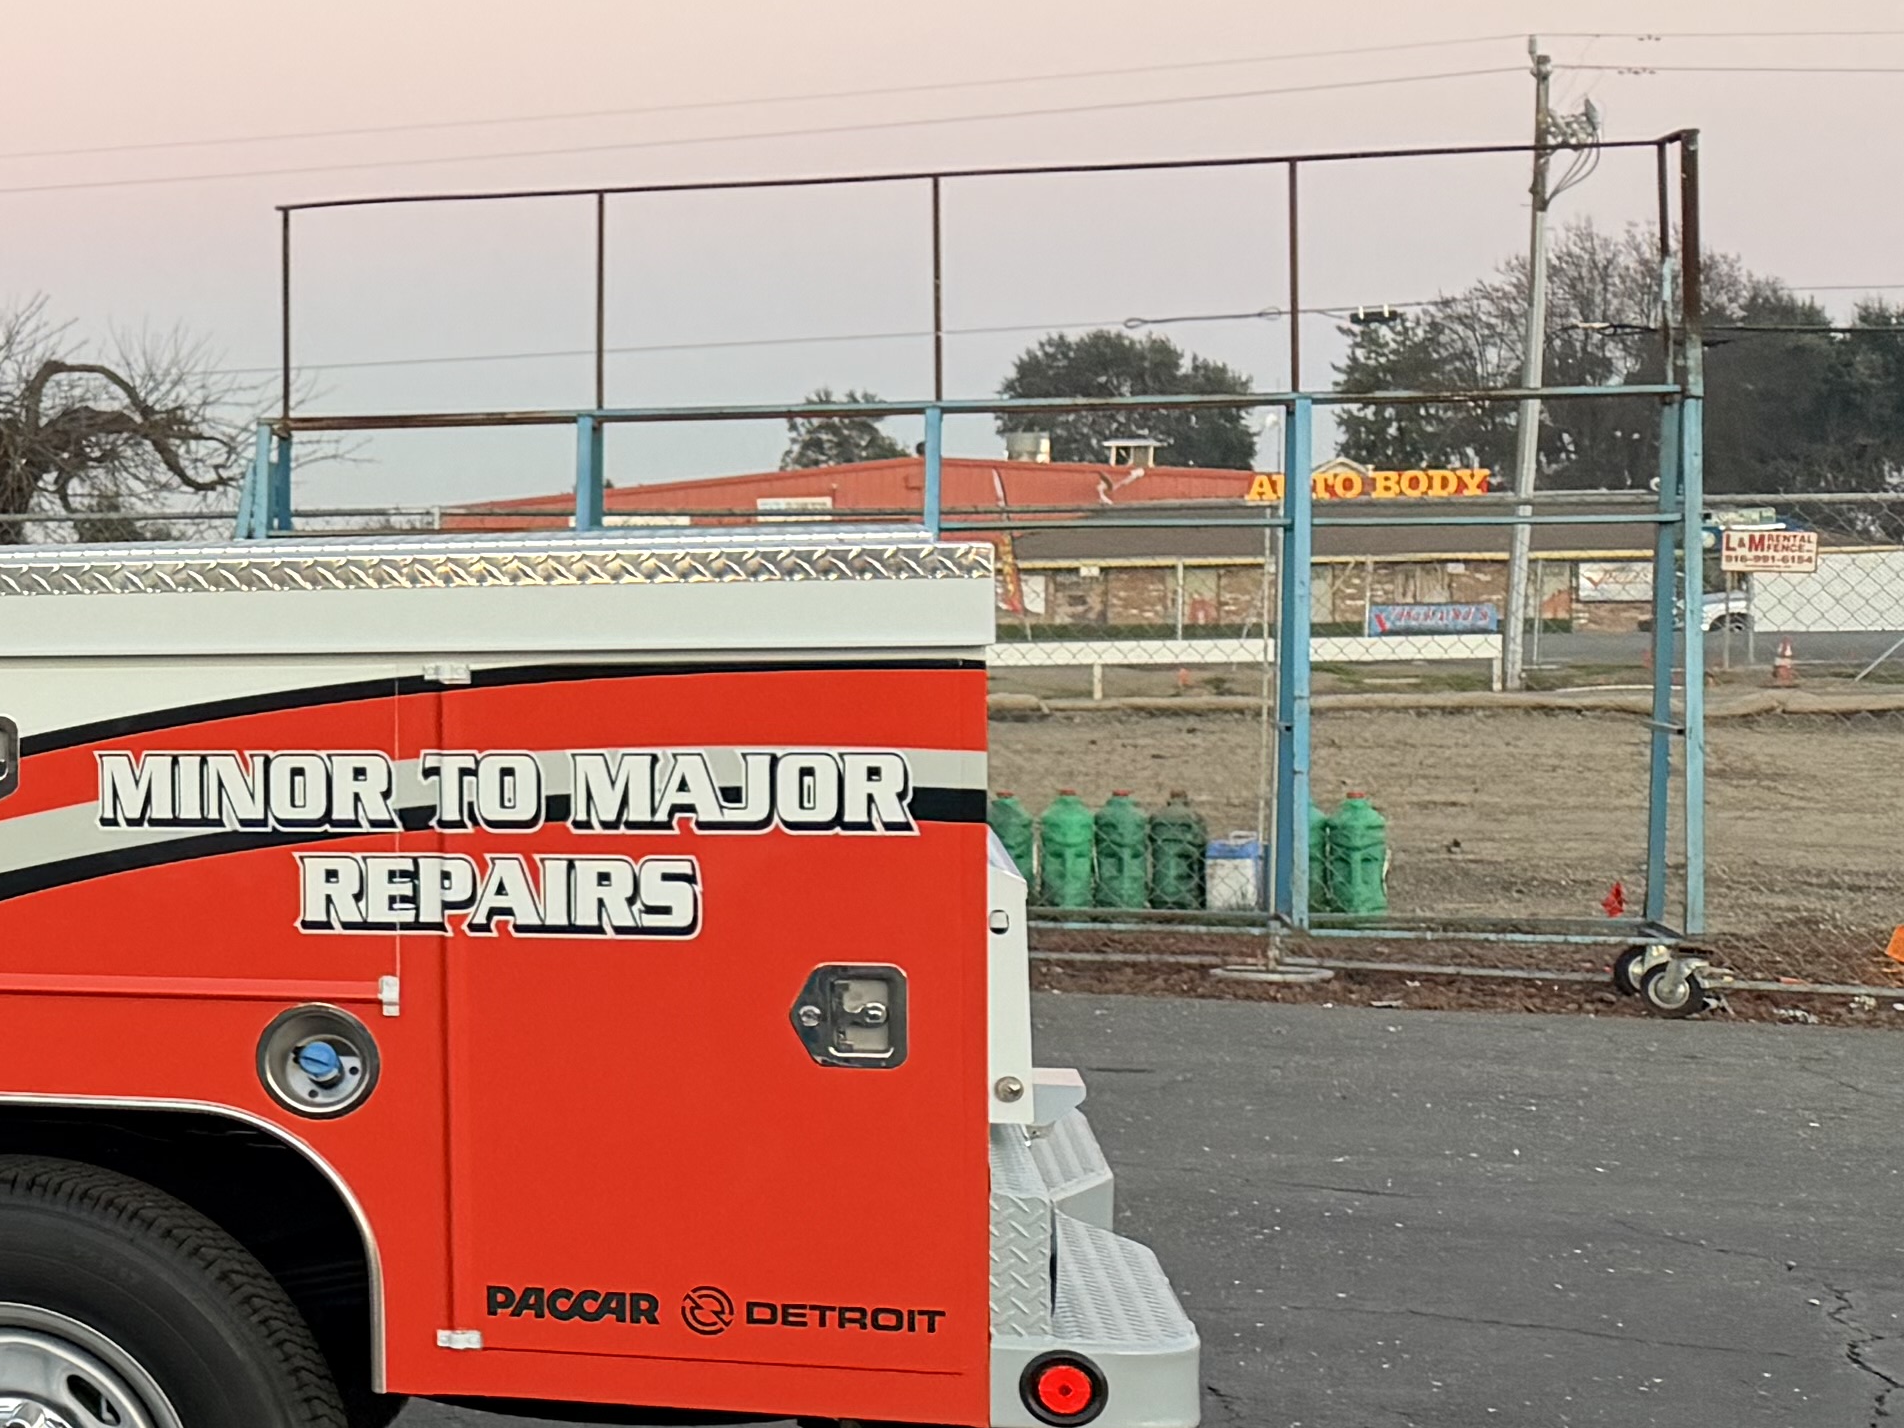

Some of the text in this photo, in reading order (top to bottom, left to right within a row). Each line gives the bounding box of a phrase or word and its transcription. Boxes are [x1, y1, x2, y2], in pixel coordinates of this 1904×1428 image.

[1371, 469, 1490, 499] BODY
[1766, 544, 1805, 553] FENCE
[1767, 534, 1814, 544] RENTAL
[96, 749, 921, 835] MINOR TO MAJOR
[293, 853, 703, 940] REPAIRS
[486, 1285, 660, 1325] PACCAR
[745, 1301, 946, 1333] DETROIT
